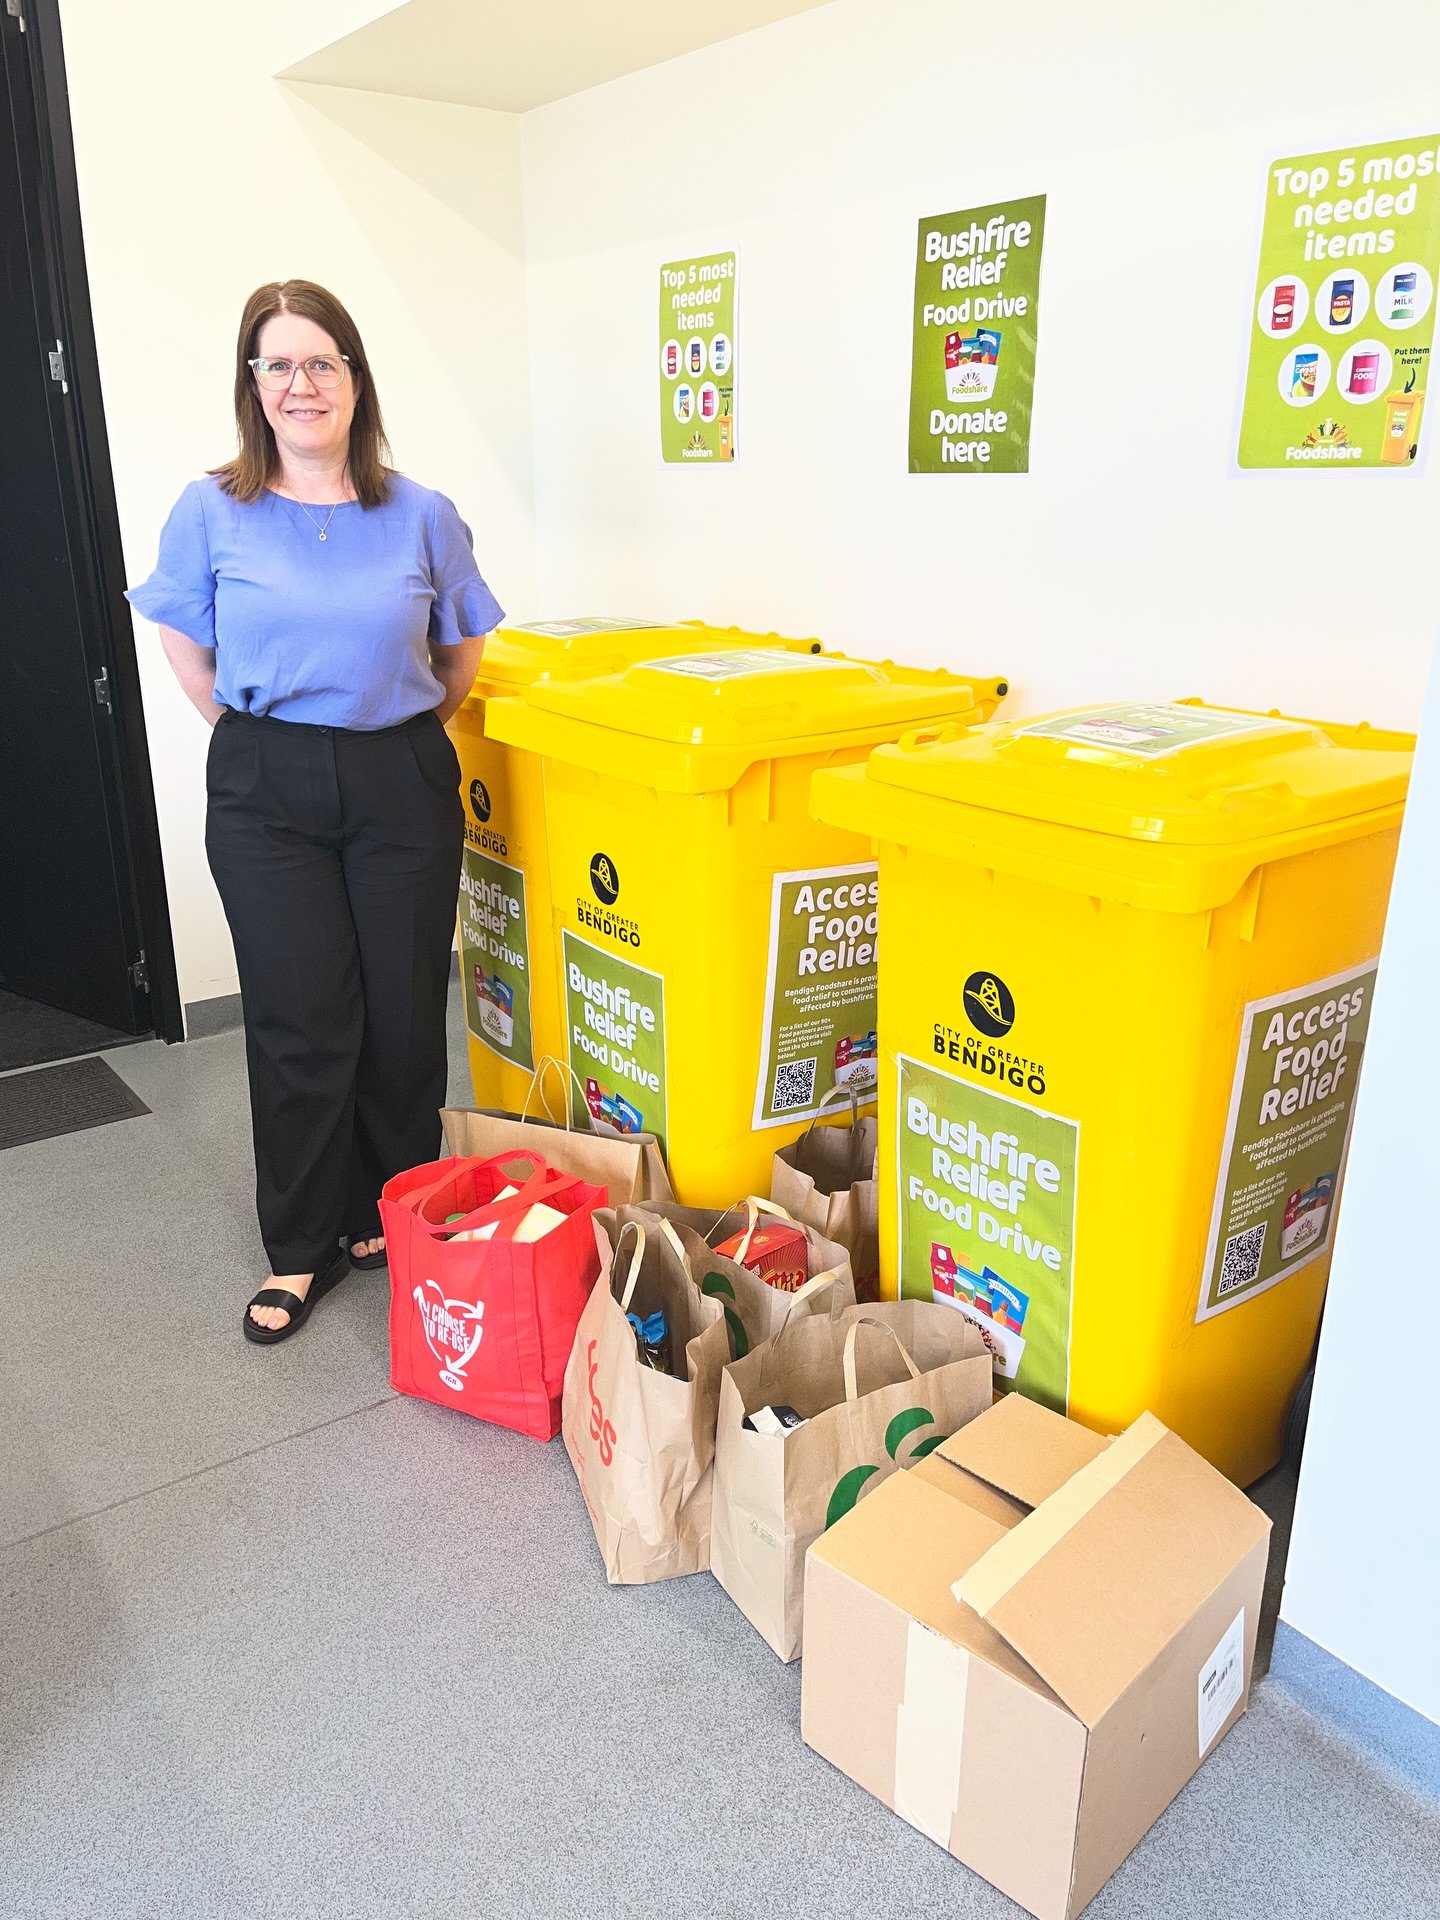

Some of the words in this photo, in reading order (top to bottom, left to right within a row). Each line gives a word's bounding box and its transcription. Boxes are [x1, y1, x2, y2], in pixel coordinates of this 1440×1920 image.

[1274, 167, 1329, 198] Top
[1337, 158, 1355, 187] 5
[1294, 183, 1416, 228] needed
[925, 215, 1031, 262] Bushfire
[1304, 229, 1395, 262] items
[662, 269, 686, 290] Top
[689, 265, 697, 284] 5
[699, 259, 733, 280] most
[941, 252, 1007, 290] Relief
[672, 283, 720, 309] needed
[923, 298, 970, 327] Food
[974, 292, 1027, 319] Drive
[1394, 298, 1413, 306] MILK
[677, 311, 714, 331] items
[1401, 357, 1422, 365] here!
[1409, 347, 1430, 355] them
[952, 385, 988, 394] Foodshare
[930, 408, 1008, 435] Donate
[682, 448, 713, 458] Foodshare
[942, 436, 990, 463] here
[1286, 446, 1363, 460] Foodshare
[483, 828, 506, 843] GREATER
[460, 869, 519, 919] Bushfire
[794, 881, 878, 915] Acces
[470, 899, 507, 936] Relief
[577, 898, 591, 910] CITY
[595, 906, 603, 916] OF
[606, 912, 639, 932] GREATER
[578, 907, 640, 947] BENDIGO
[463, 920, 486, 952] Food
[490, 937, 525, 970] Drive
[569, 962, 655, 1032] Bushfire
[785, 986, 814, 997] Bendigo
[816, 980, 852, 991] Foodshare
[860, 973, 877, 983] provi
[793, 995, 810, 1005] food
[811, 992, 830, 1002] relief
[841, 983, 878, 996] communiti
[800, 1001, 830, 1013] affected
[841, 993, 875, 1004] bushfires.
[1262, 987, 1364, 1051] Access
[584, 1002, 637, 1051] Relief
[778, 1038, 798, 1046] central
[798, 1033, 820, 1042] Victoria
[792, 1027, 816, 1037] partners
[574, 1025, 608, 1065] Food
[611, 1050, 659, 1093] Drive
[934, 1023, 960, 1041] CITY
[967, 1037, 982, 1050] OF
[988, 1046, 1044, 1076] GREATER
[934, 1034, 1045, 1095] BENDIGO
[1273, 1021, 1347, 1084] Food
[1259, 1056, 1347, 1125] Relief
[907, 1096, 1061, 1193] Bushfire
[1242, 1137, 1272, 1153] Bendigo
[1275, 1120, 1310, 1140] Foodshare
[1311, 1116, 1317, 1125] is
[1317, 1102, 1345, 1122] providing
[1249, 1150, 1268, 1162] food
[1269, 1140, 1289, 1154] relief
[1290, 1137, 1297, 1146] to
[1298, 1116, 1336, 1141] communities
[1255, 1151, 1287, 1170] affected
[1288, 1147, 1297, 1157] by
[1298, 1131, 1327, 1151] bushfires.
[932, 1147, 1026, 1215] Relief
[1232, 1195, 1246, 1206] food
[1246, 1185, 1271, 1200] partners
[1271, 1177, 1287, 1189] across
[1233, 1189, 1243, 1197] For
[1249, 1182, 1258, 1191] list
[1258, 1178, 1265, 1187] of
[1265, 1175, 1275, 1184] our
[1229, 1214, 1243, 1223] scan
[1244, 1208, 1253, 1218] the
[1254, 1203, 1262, 1214] QR
[1262, 1199, 1275, 1209] code
[1231, 1202, 1250, 1214] central
[1252, 1193, 1272, 1207] Victoria
[1273, 1186, 1284, 1196] visit
[909, 1176, 972, 1231] Food
[978, 1211, 1061, 1271] Drive
[1228, 1218, 1248, 1232] below!
[1286, 1228, 1317, 1251] Foodshare
[426, 1319, 435, 1337] TO
[438, 1324, 470, 1353] RE-USE
[432, 1304, 466, 1336] CHOOSE
